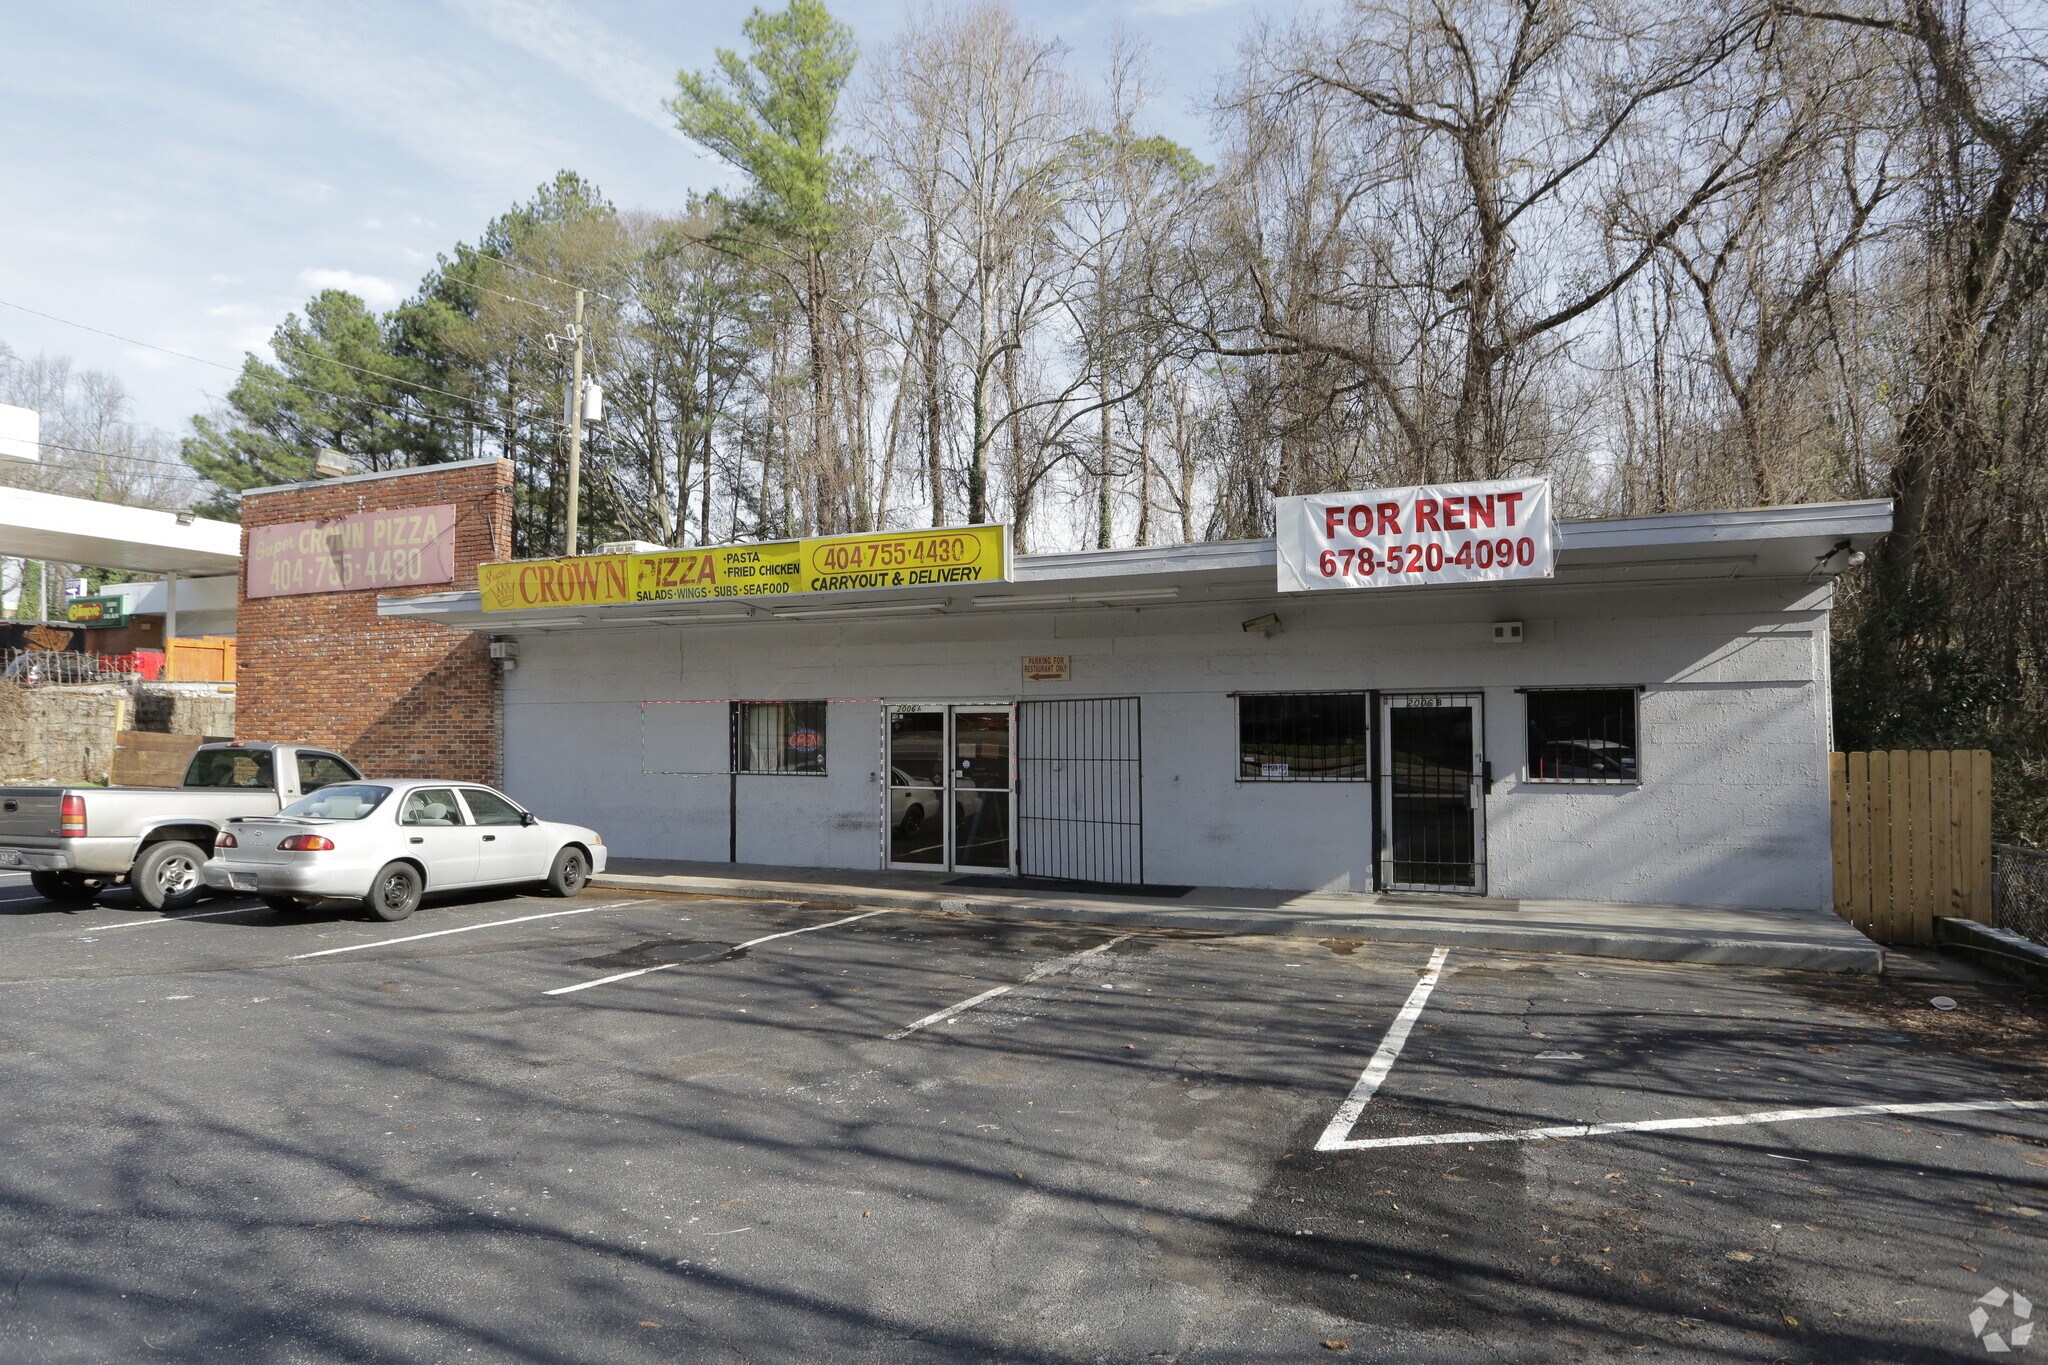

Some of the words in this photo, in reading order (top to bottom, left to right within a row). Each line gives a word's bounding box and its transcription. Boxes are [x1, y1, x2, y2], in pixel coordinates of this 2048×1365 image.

[1325, 501, 1402, 539] FOR
[1415, 491, 1523, 533] RENT
[255, 535, 296, 561] Super
[299, 521, 365, 555] CROWN
[373, 514, 438, 548] PIZZA
[726, 552, 760, 564] PASTA
[1319, 537, 1535, 577] 678-520-4090
[727, 565, 756, 578] FRIED
[759, 563, 800, 576] CHICKEN
[519, 560, 628, 604] CROWN
[637, 554, 717, 589] PIZZA
[811, 572, 889, 592] CARRYOUT
[891, 571, 905, 586] &
[908, 566, 982, 585] DELIVERY
[636, 589, 674, 602] SALADS
[676, 587, 708, 598] WINGS
[714, 585, 738, 597] SUBS
[743, 582, 790, 595] SEAFOOD
[1028, 656, 1051, 664] PARKING
[1053, 656, 1065, 664] FOR
[1024, 664, 1054, 673] RESTAURANT
[1055, 664, 1068, 673] ONLY
[896, 705, 916, 713] 2006
[1407, 698, 1433, 707] 2006
[789, 734, 821, 747] OPEN
